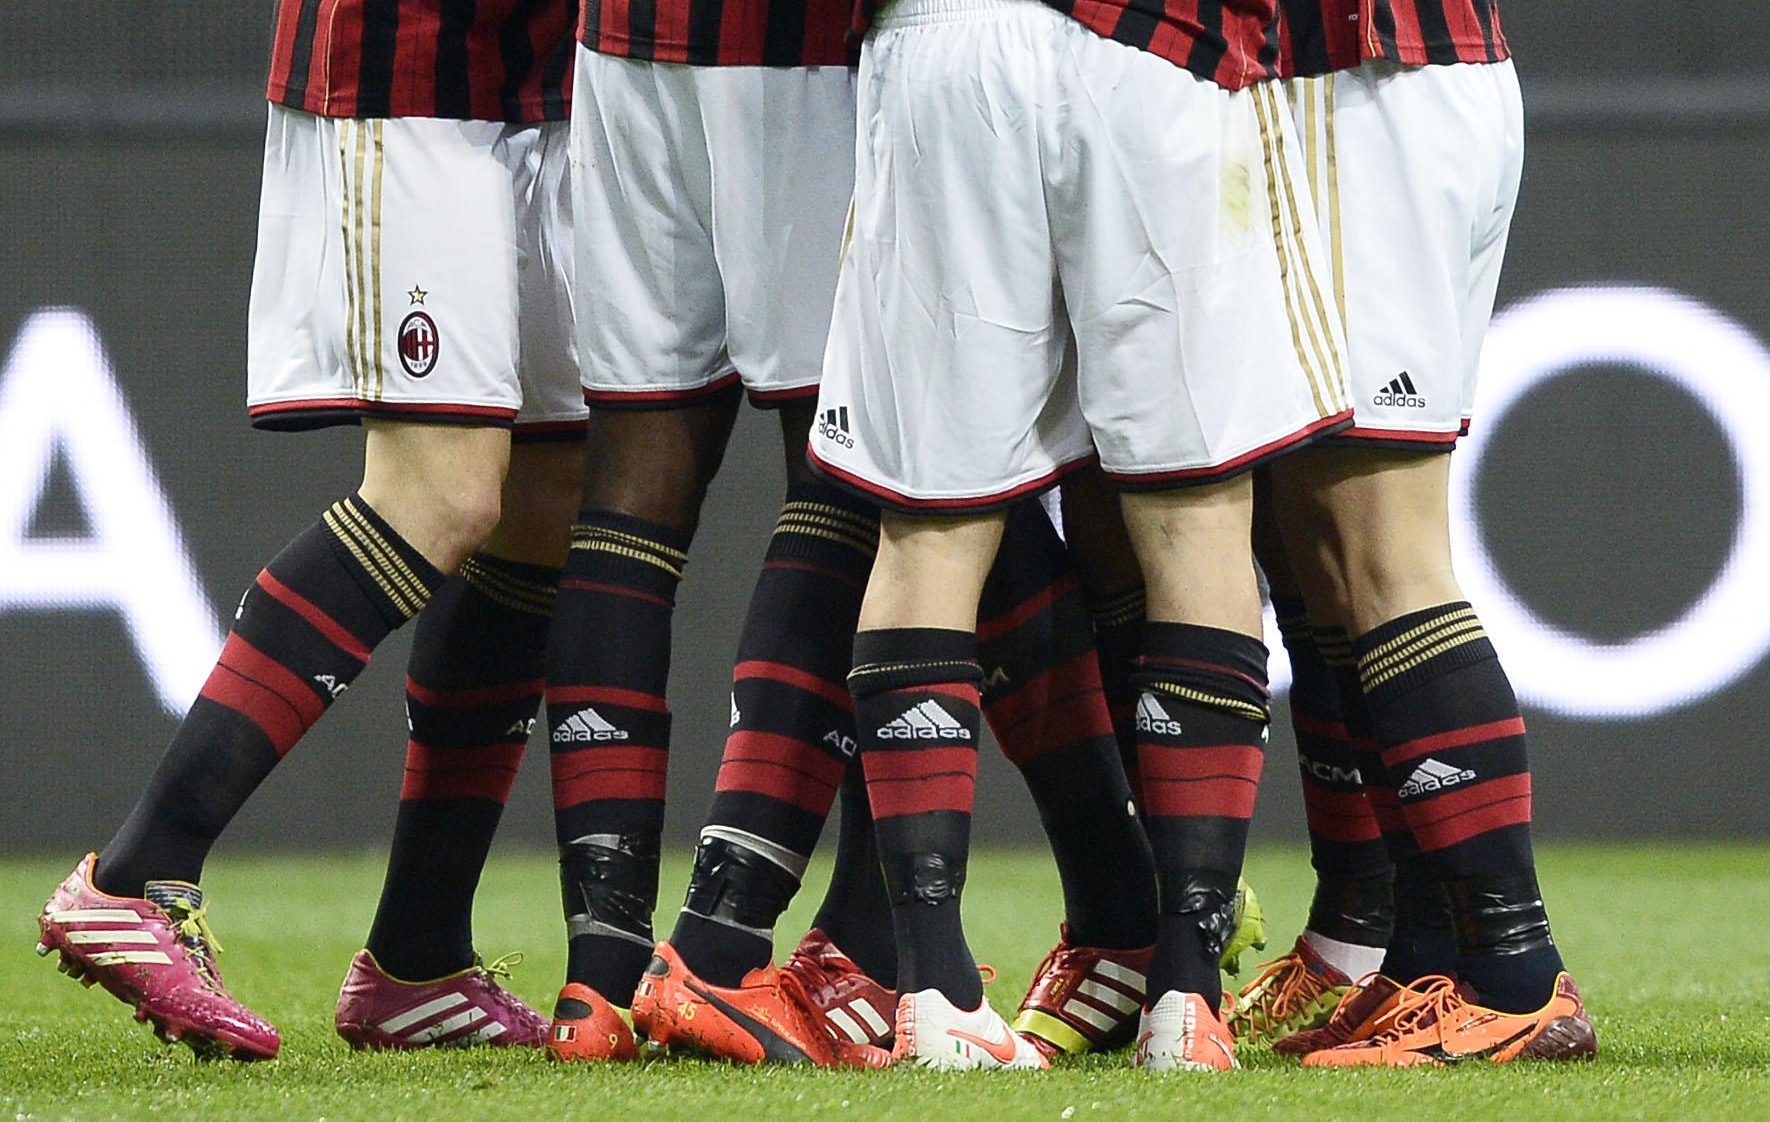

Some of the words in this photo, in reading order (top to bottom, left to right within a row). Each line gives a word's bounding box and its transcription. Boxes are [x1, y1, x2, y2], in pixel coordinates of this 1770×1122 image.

[1373, 391, 1426, 408] adidas
[553, 728, 629, 742] adidas
[877, 724, 971, 739] adidas
[1398, 769, 1476, 798] adidas
[677, 1001, 697, 1020] 45
[608, 1033, 618, 1050] 9
